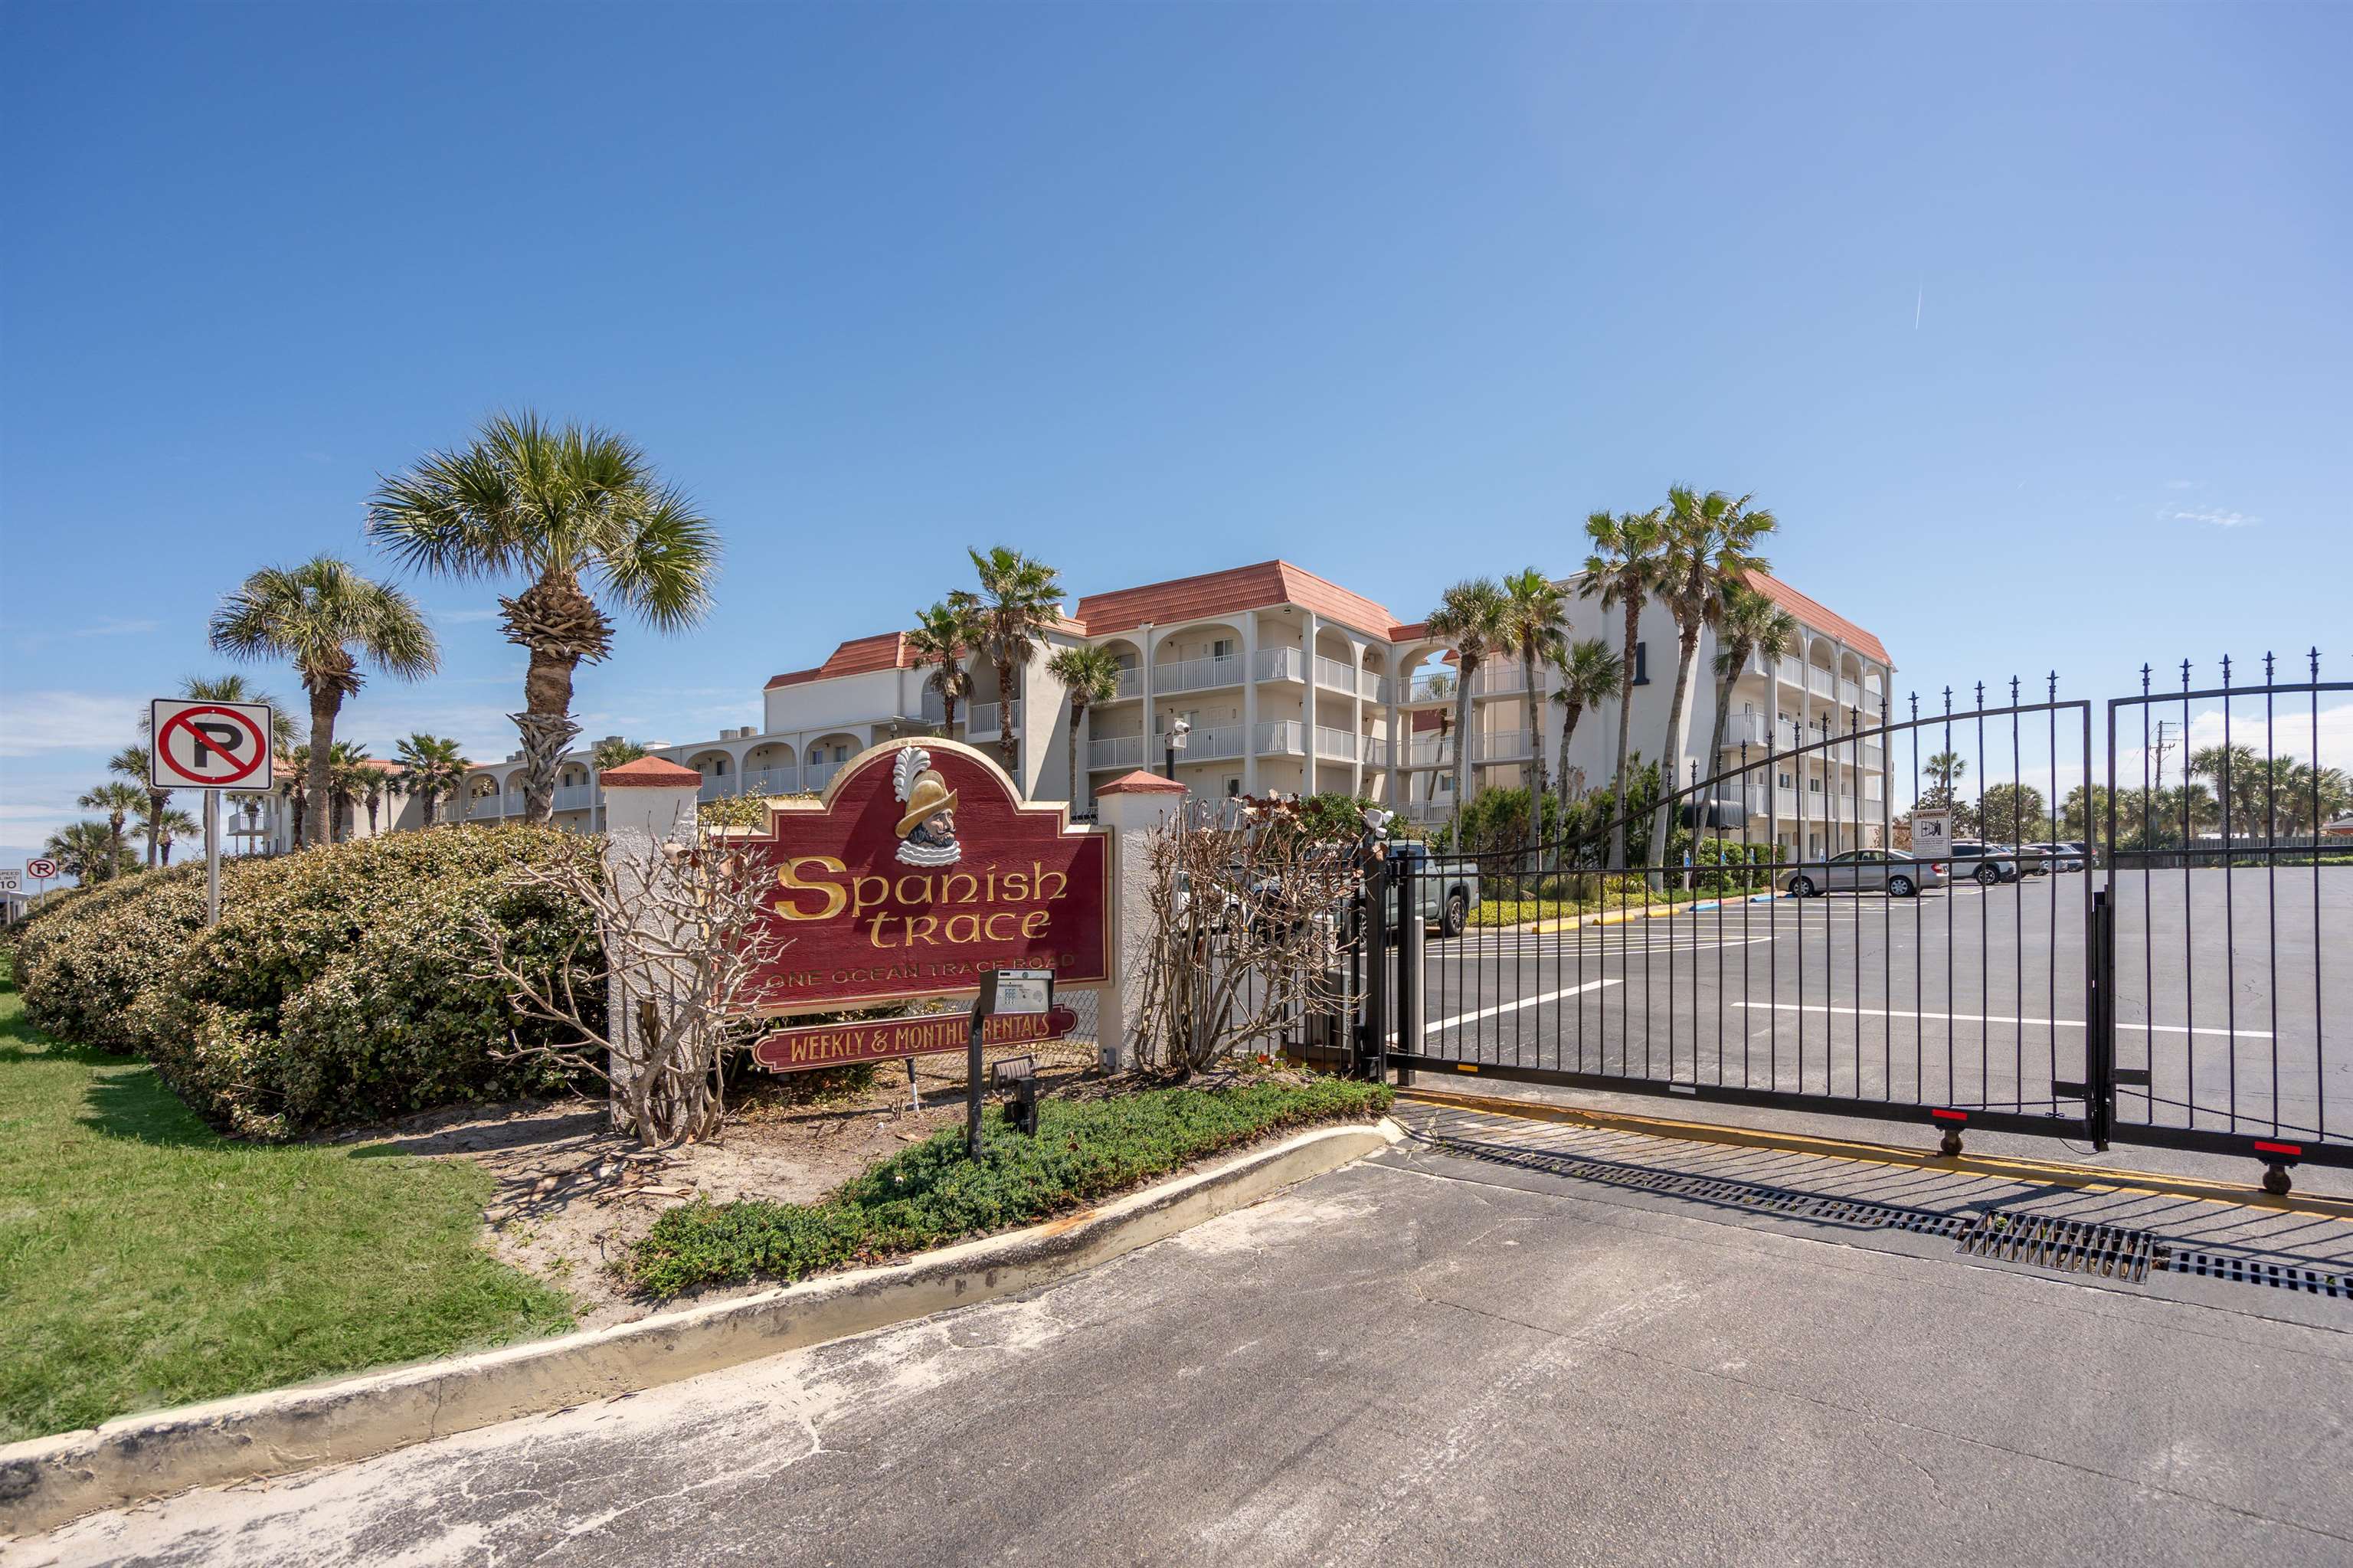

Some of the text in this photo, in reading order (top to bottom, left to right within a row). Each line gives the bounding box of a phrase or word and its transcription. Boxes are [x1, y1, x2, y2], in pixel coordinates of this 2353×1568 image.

[774, 856, 1067, 921] Spanish
[766, 954, 1075, 989] ONE OCEAN TRACE ROAD
[791, 1031, 866, 1062] WEEKLY
[871, 1030, 888, 1053] &
[981, 1013, 1049, 1042] RENTALS
